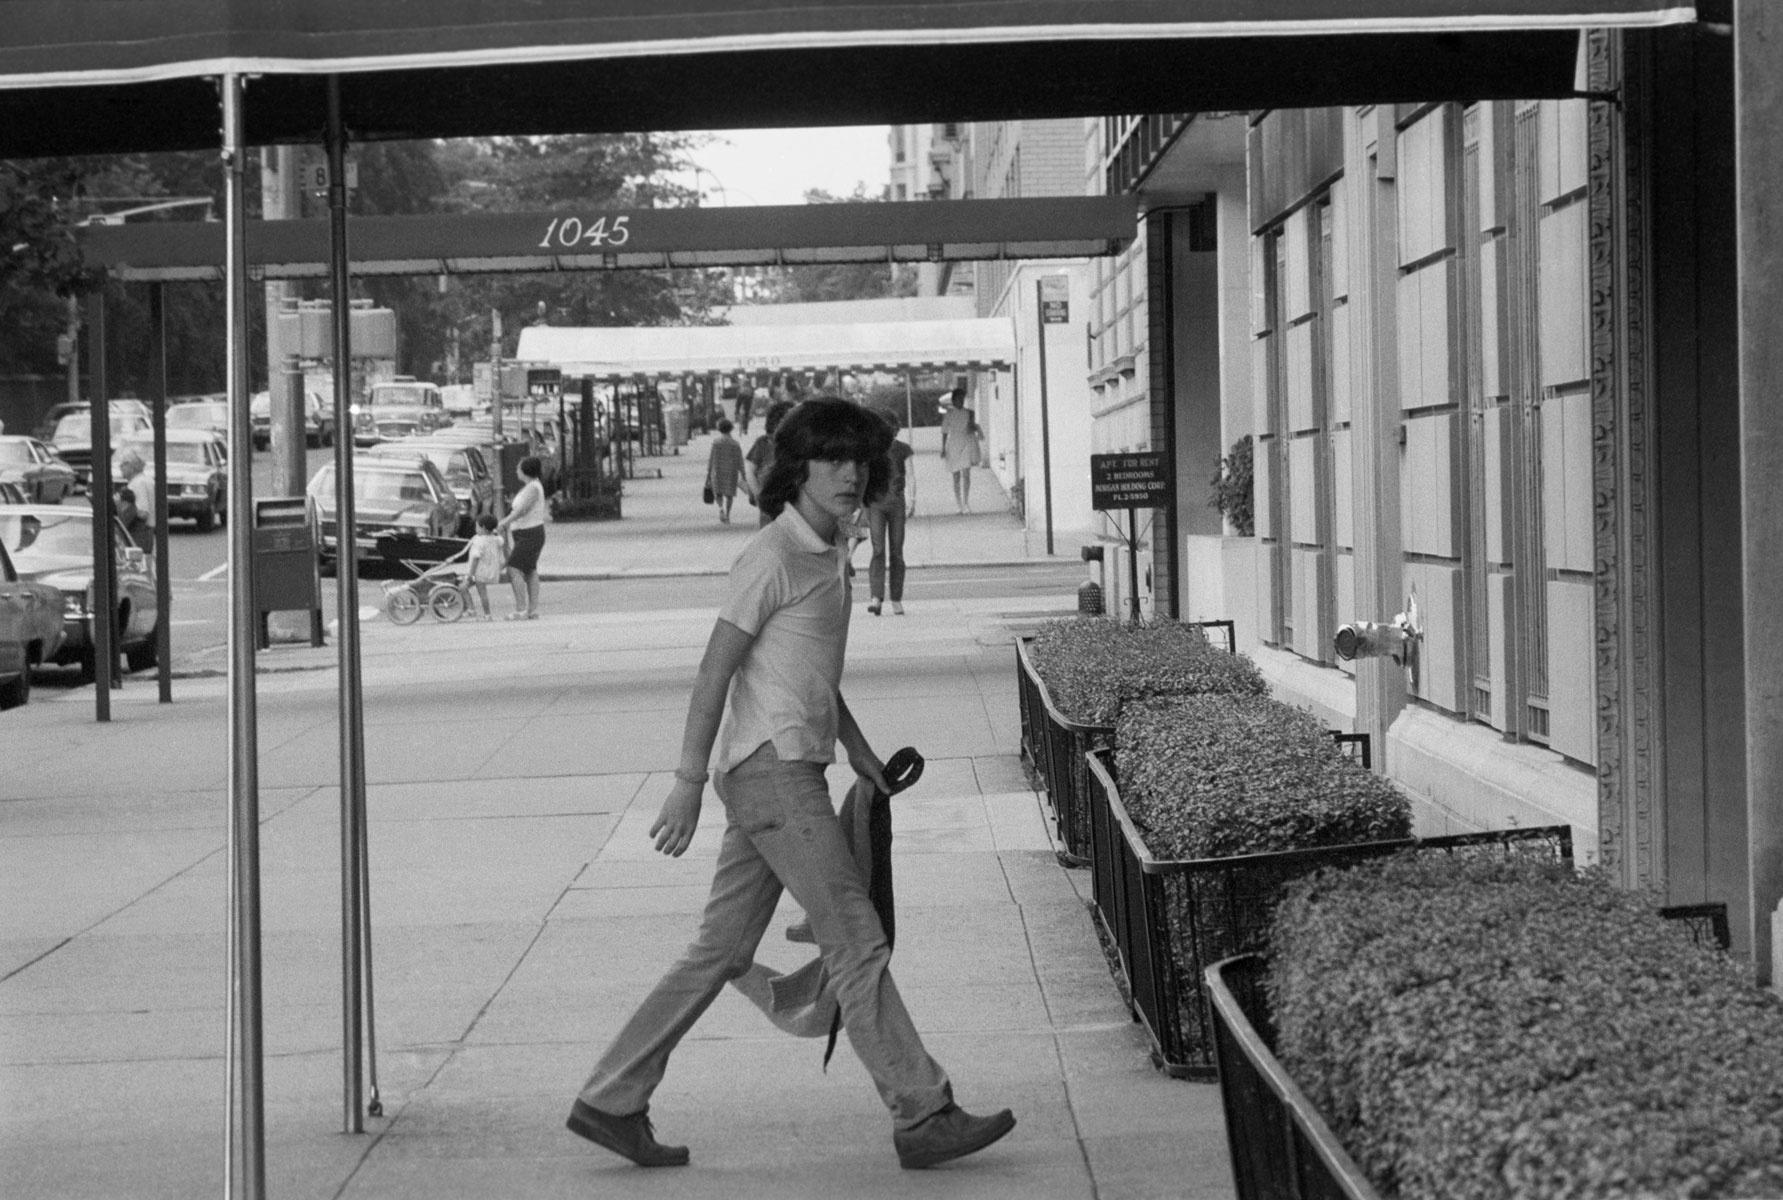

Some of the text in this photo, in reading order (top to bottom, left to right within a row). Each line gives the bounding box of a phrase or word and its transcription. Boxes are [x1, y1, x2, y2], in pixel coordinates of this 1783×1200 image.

[538, 216, 629, 247] 1045
[1123, 459, 1138, 468] FOR
[1139, 458, 1159, 467] RENT
[1106, 471, 1154, 480] 2 BEDROOMS
